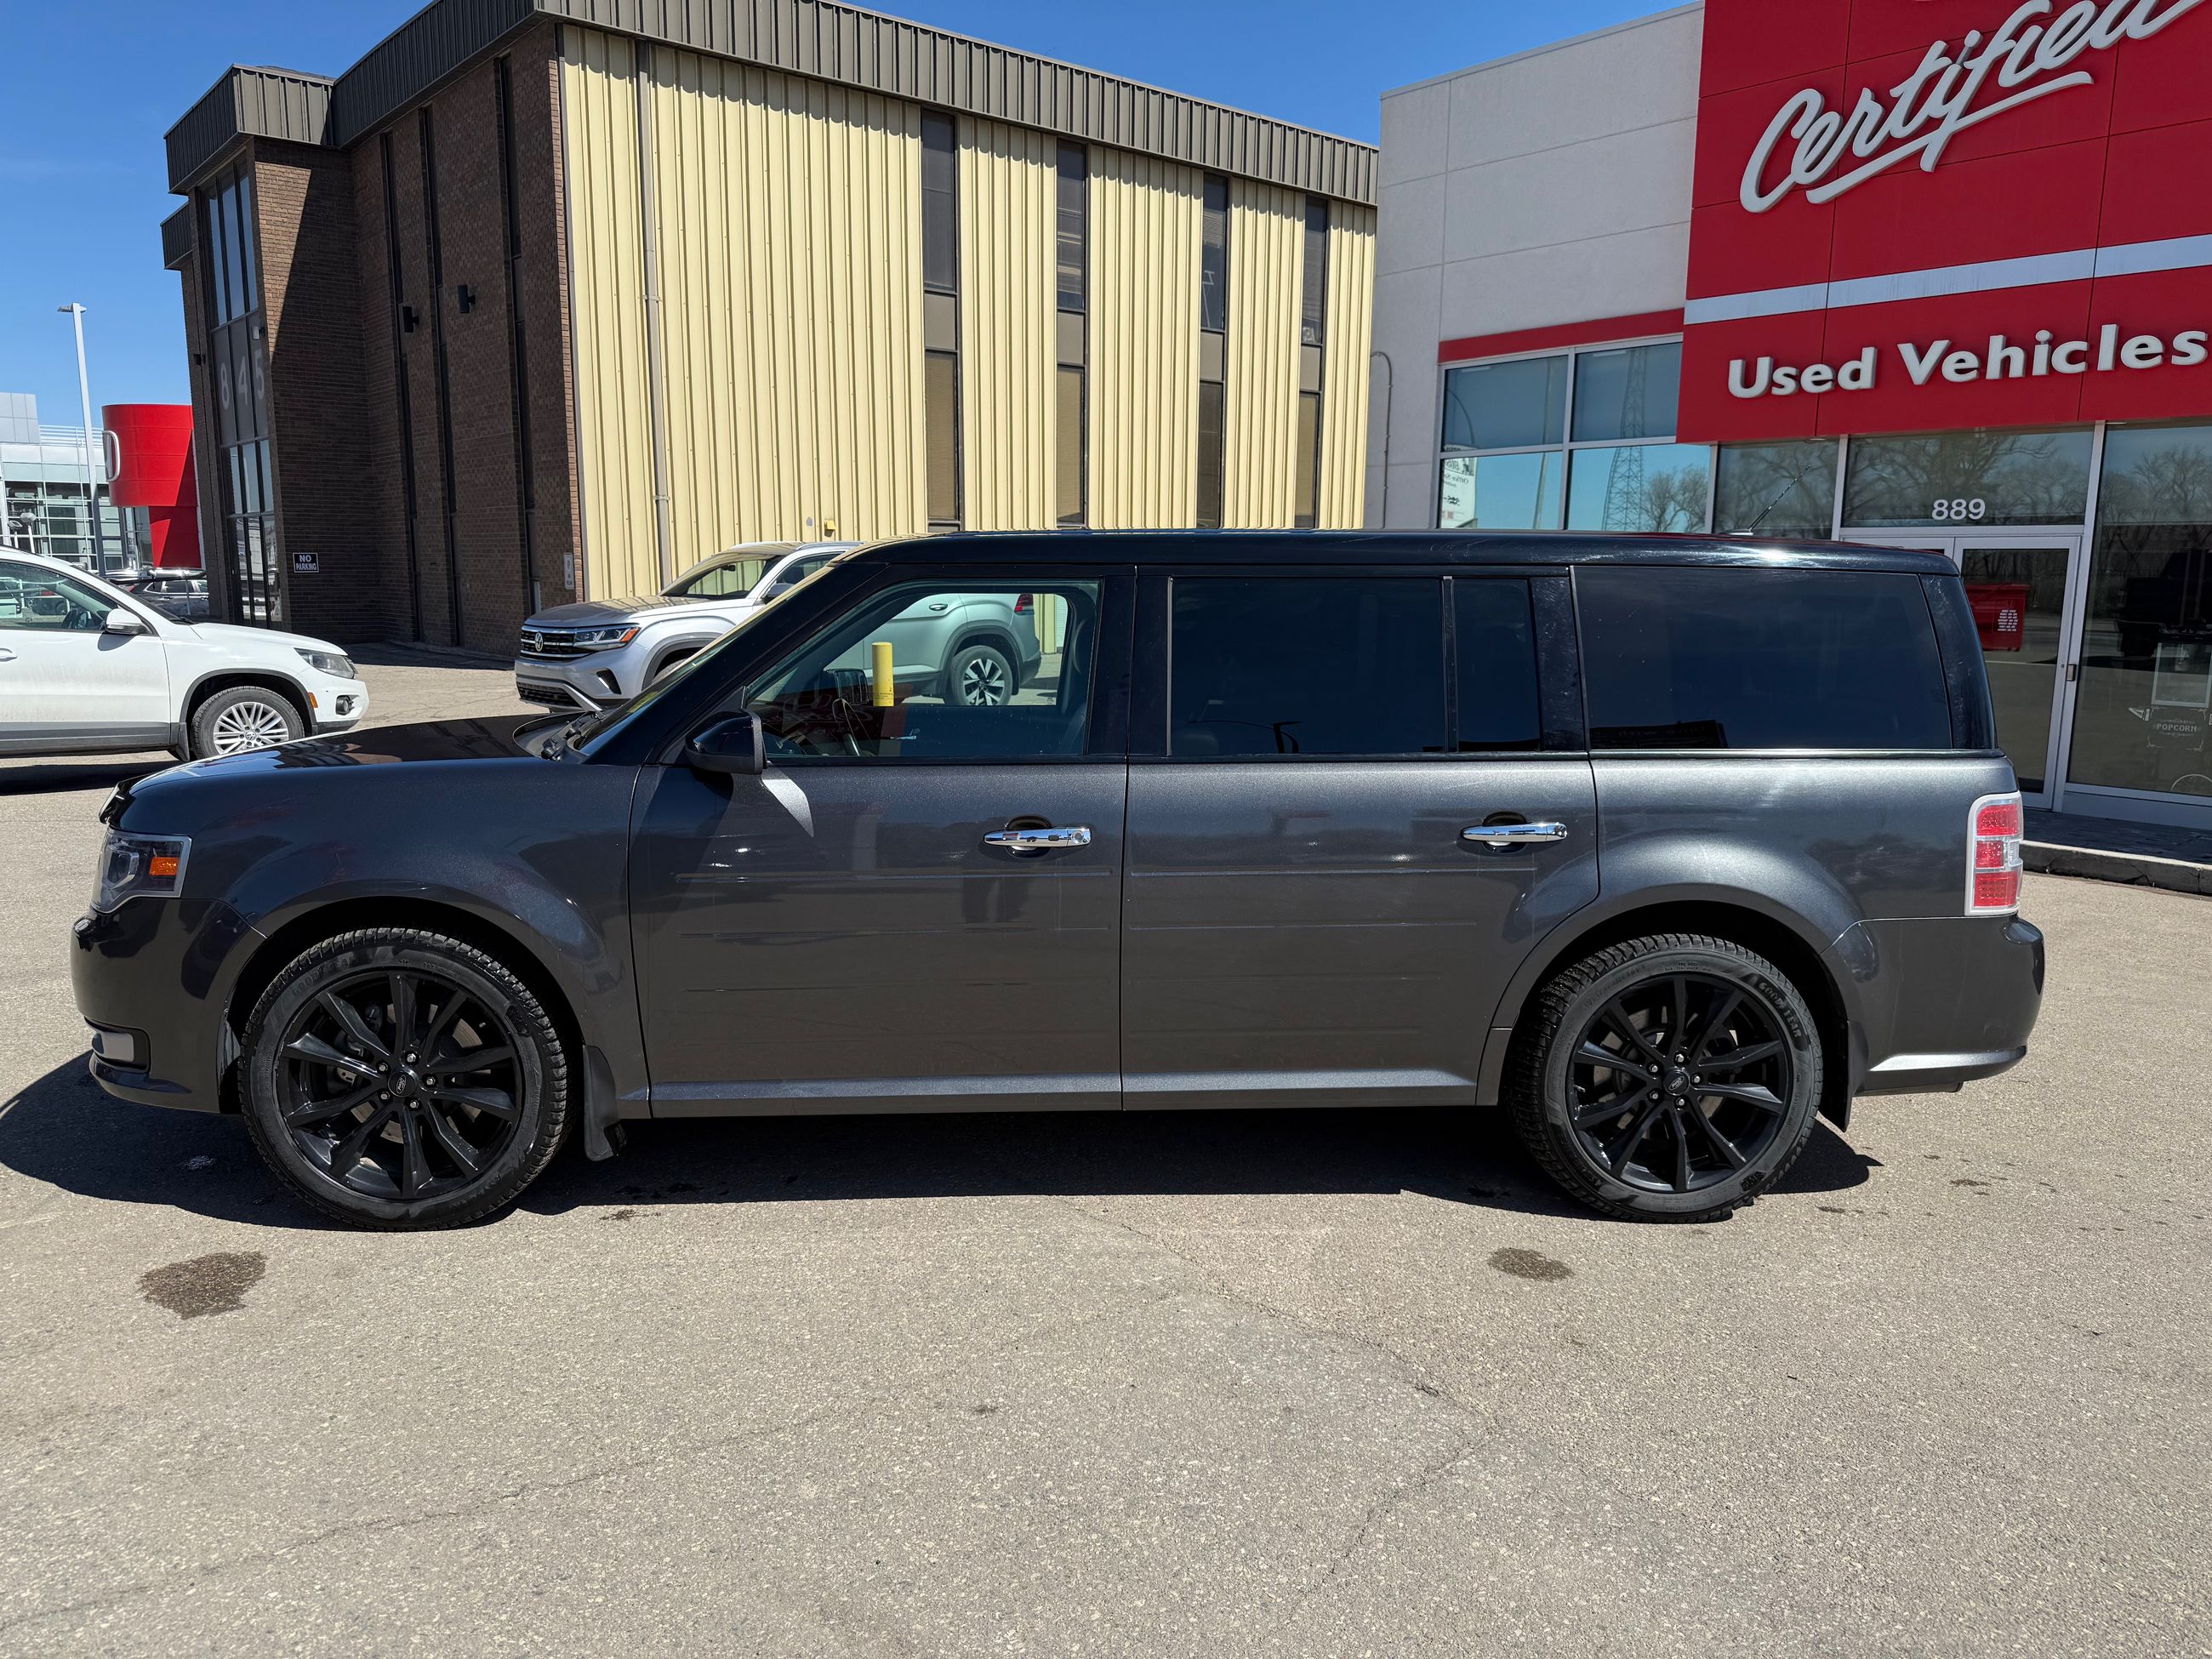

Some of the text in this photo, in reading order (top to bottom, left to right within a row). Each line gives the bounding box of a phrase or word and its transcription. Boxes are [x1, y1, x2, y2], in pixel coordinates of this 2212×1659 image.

[1728, 324, 2209, 398] Used Vehicles
[221, 348, 265, 410] 845
[1931, 498, 1986, 521] 889
[299, 554, 312, 562] NO
[295, 562, 317, 571] PARKING
[2157, 723, 2198, 733] POPCORN
